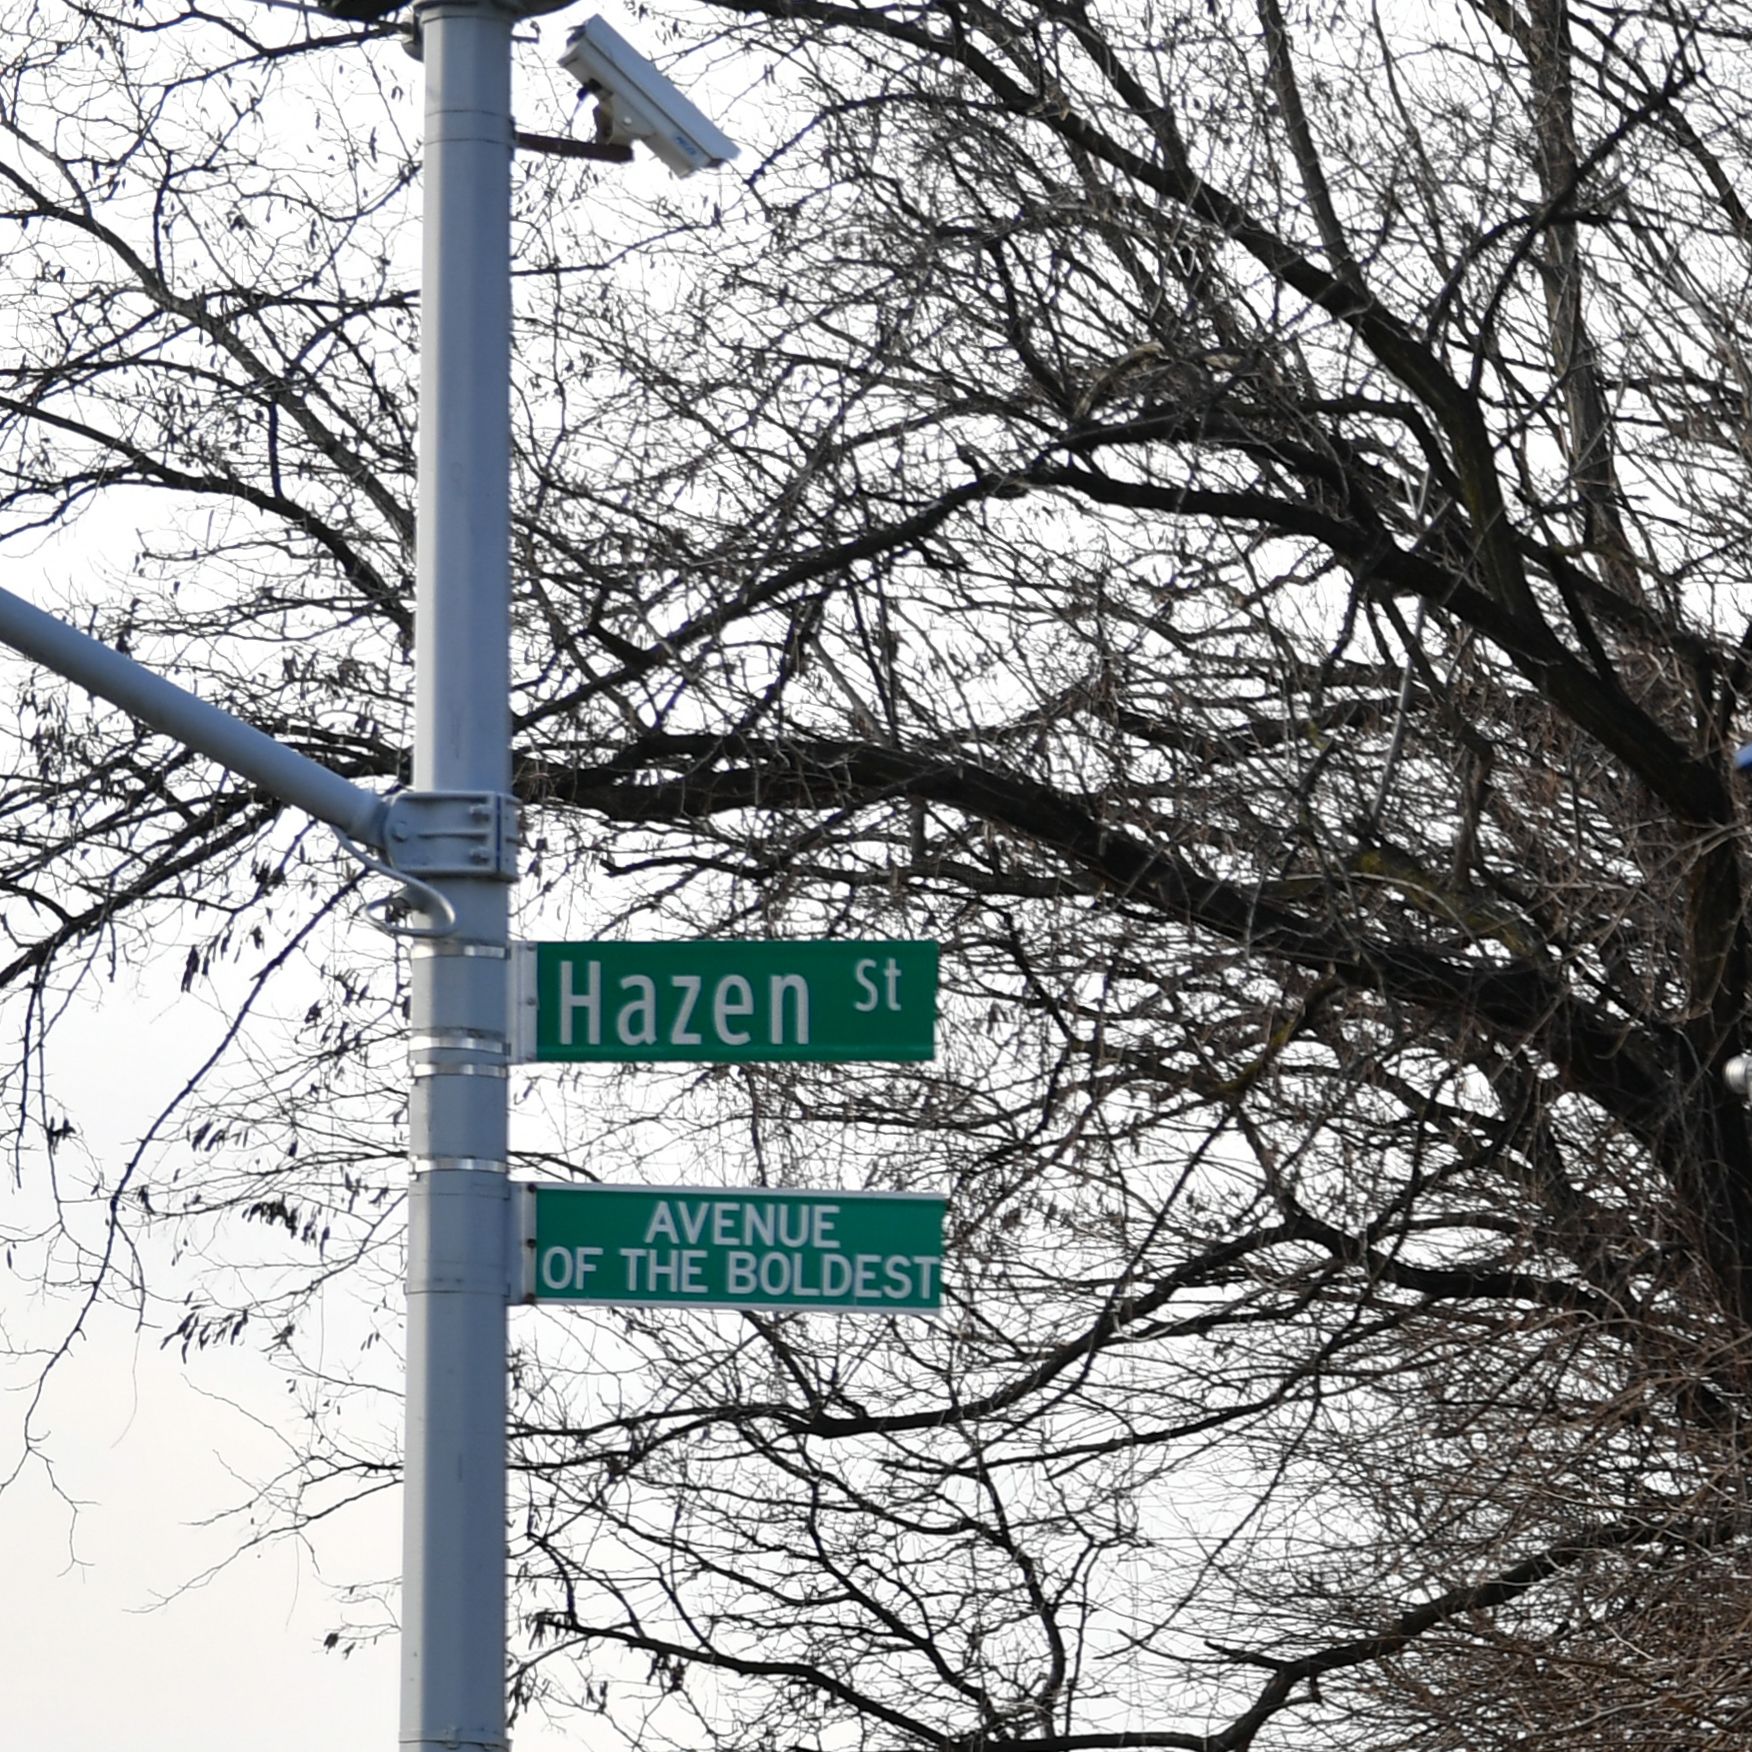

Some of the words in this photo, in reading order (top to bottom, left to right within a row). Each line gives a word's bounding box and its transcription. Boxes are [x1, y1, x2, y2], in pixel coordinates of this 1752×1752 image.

[558, 959, 811, 1045] Hazen
[853, 958, 902, 1013] St
[644, 1201, 841, 1248] AVENUE
[542, 1246, 603, 1290] OF
[620, 1248, 708, 1294] THE
[726, 1251, 941, 1300] BOLDEST
